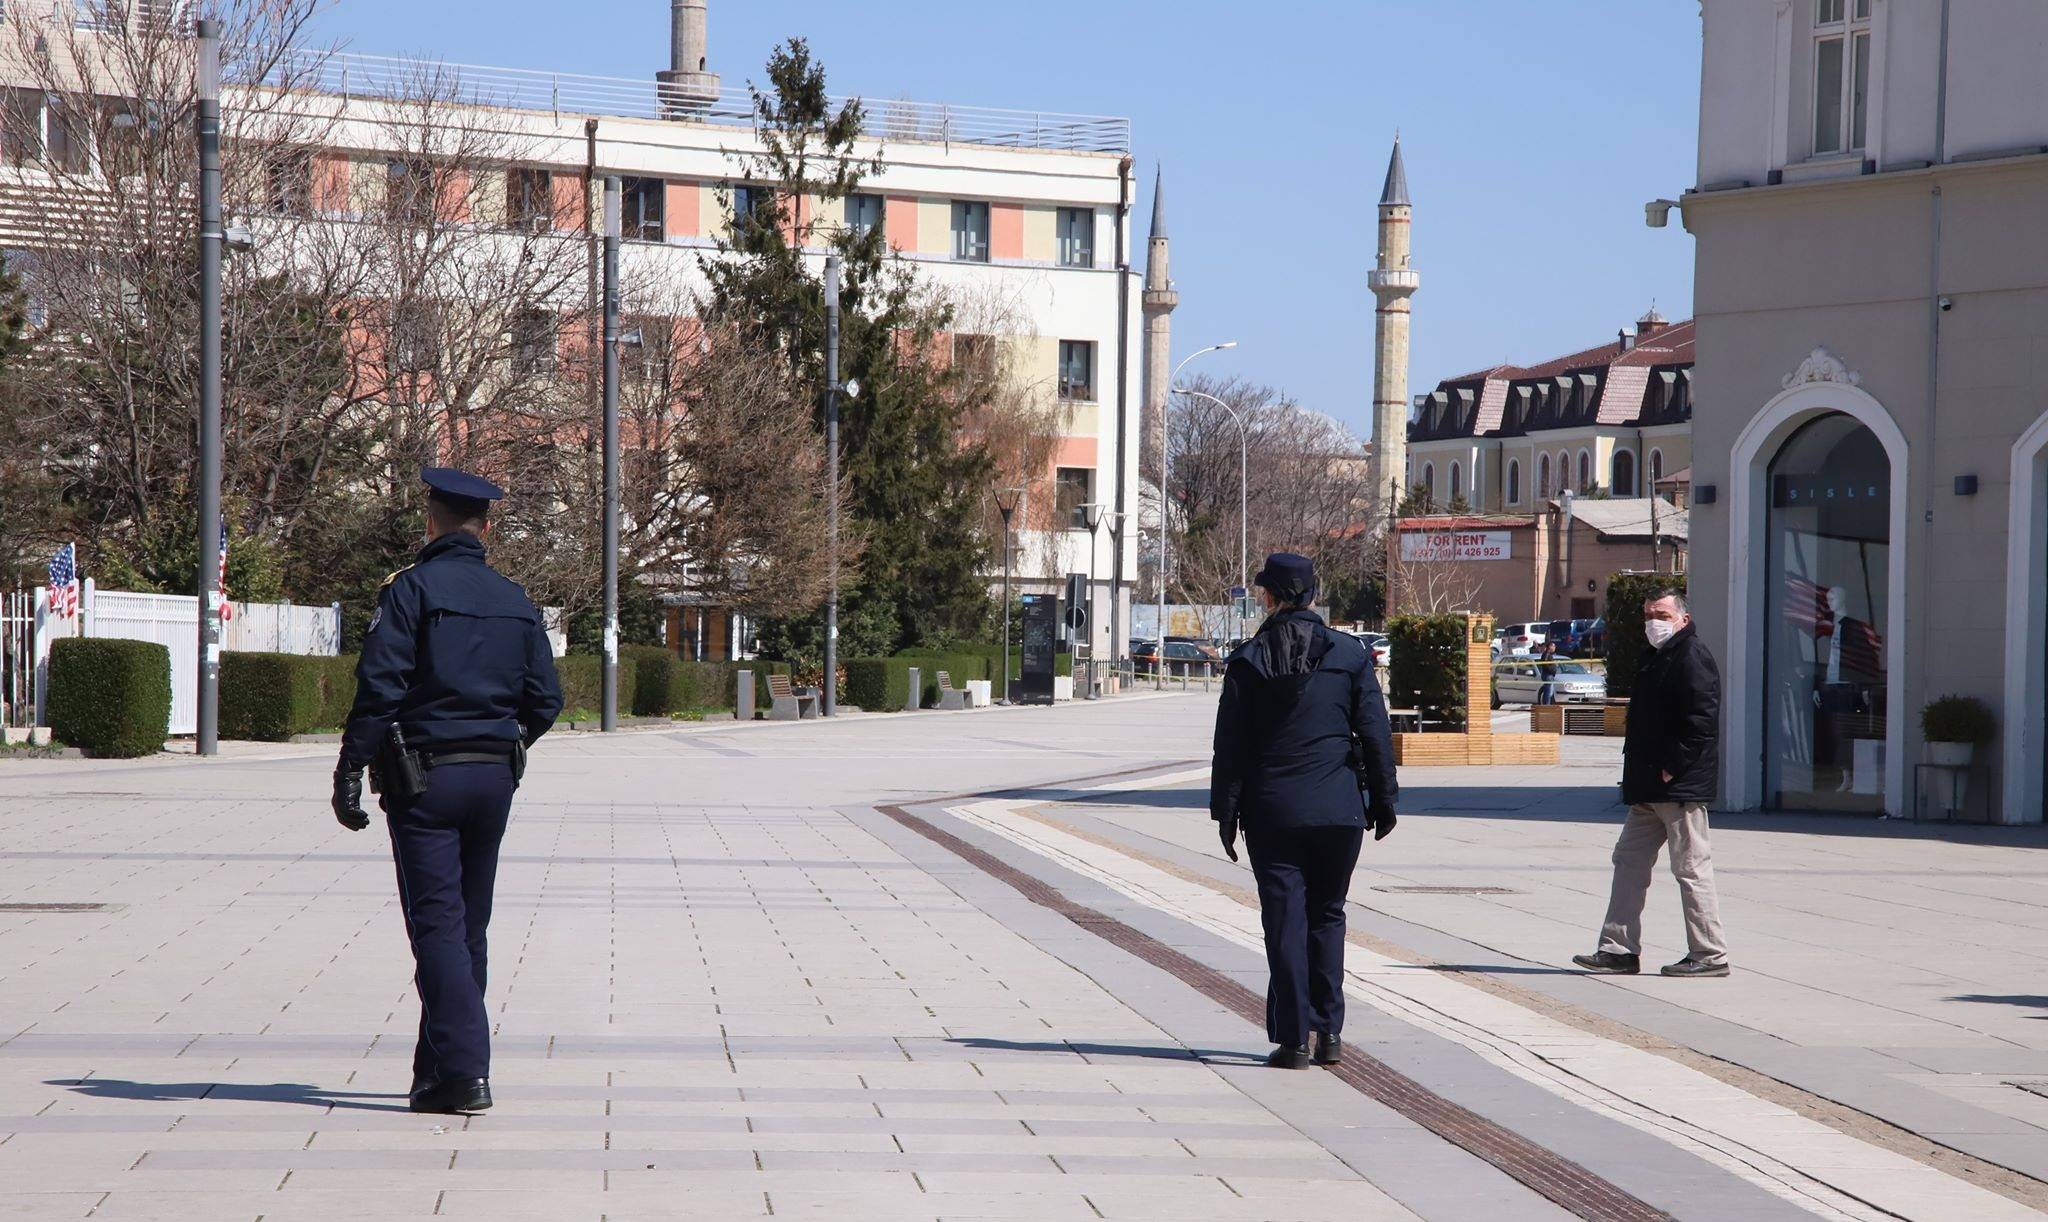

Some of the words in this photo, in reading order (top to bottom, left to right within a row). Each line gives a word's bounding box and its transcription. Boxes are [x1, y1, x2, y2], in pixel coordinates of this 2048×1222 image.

[1790, 486, 1876, 499] SISLE
[1427, 535, 1450, 546] FOR
[1455, 534, 1487, 546] RENT
[1465, 547, 1481, 557] 426
[1484, 547, 1500, 556] 925
